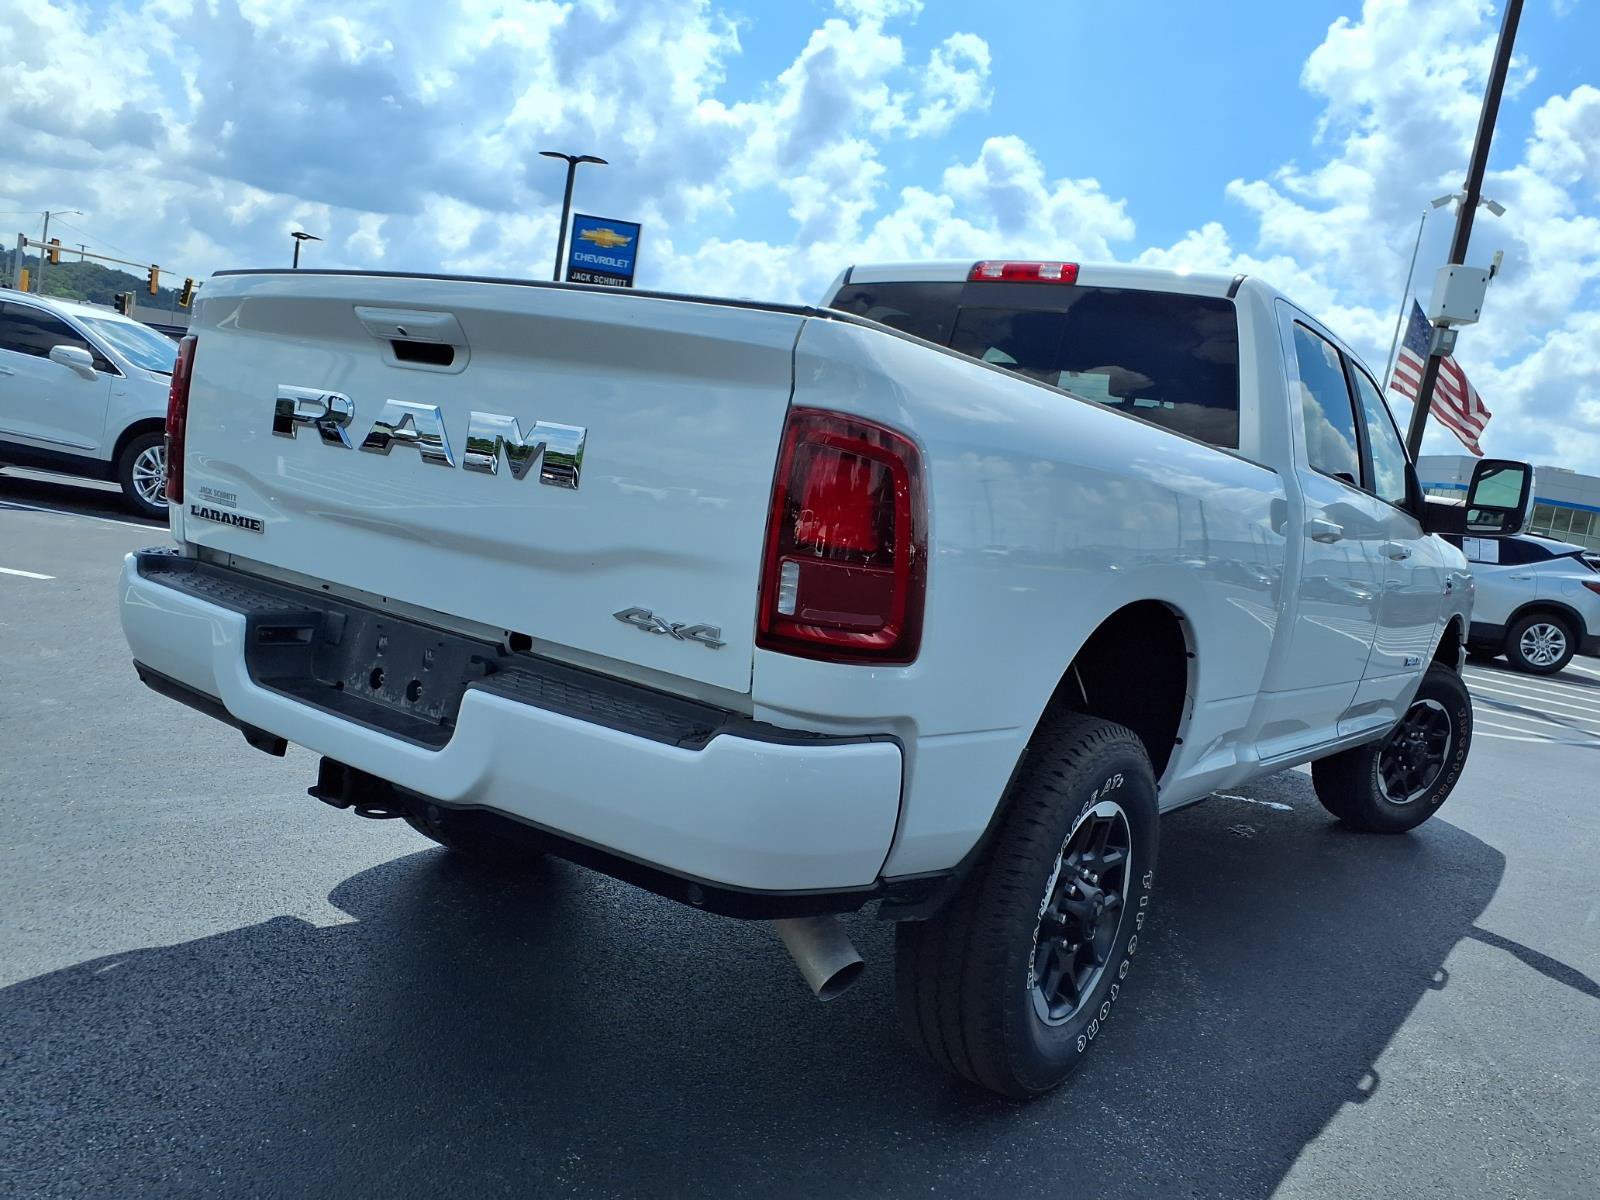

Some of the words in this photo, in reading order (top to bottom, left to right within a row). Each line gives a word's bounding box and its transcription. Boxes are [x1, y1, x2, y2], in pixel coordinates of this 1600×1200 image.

[574, 252, 630, 268] CHEVROLET
[571, 272, 591, 282] JACK
[593, 275, 627, 287] SCHMITT
[272, 384, 588, 490] RAM
[190, 504, 262, 532] LARAMIE
